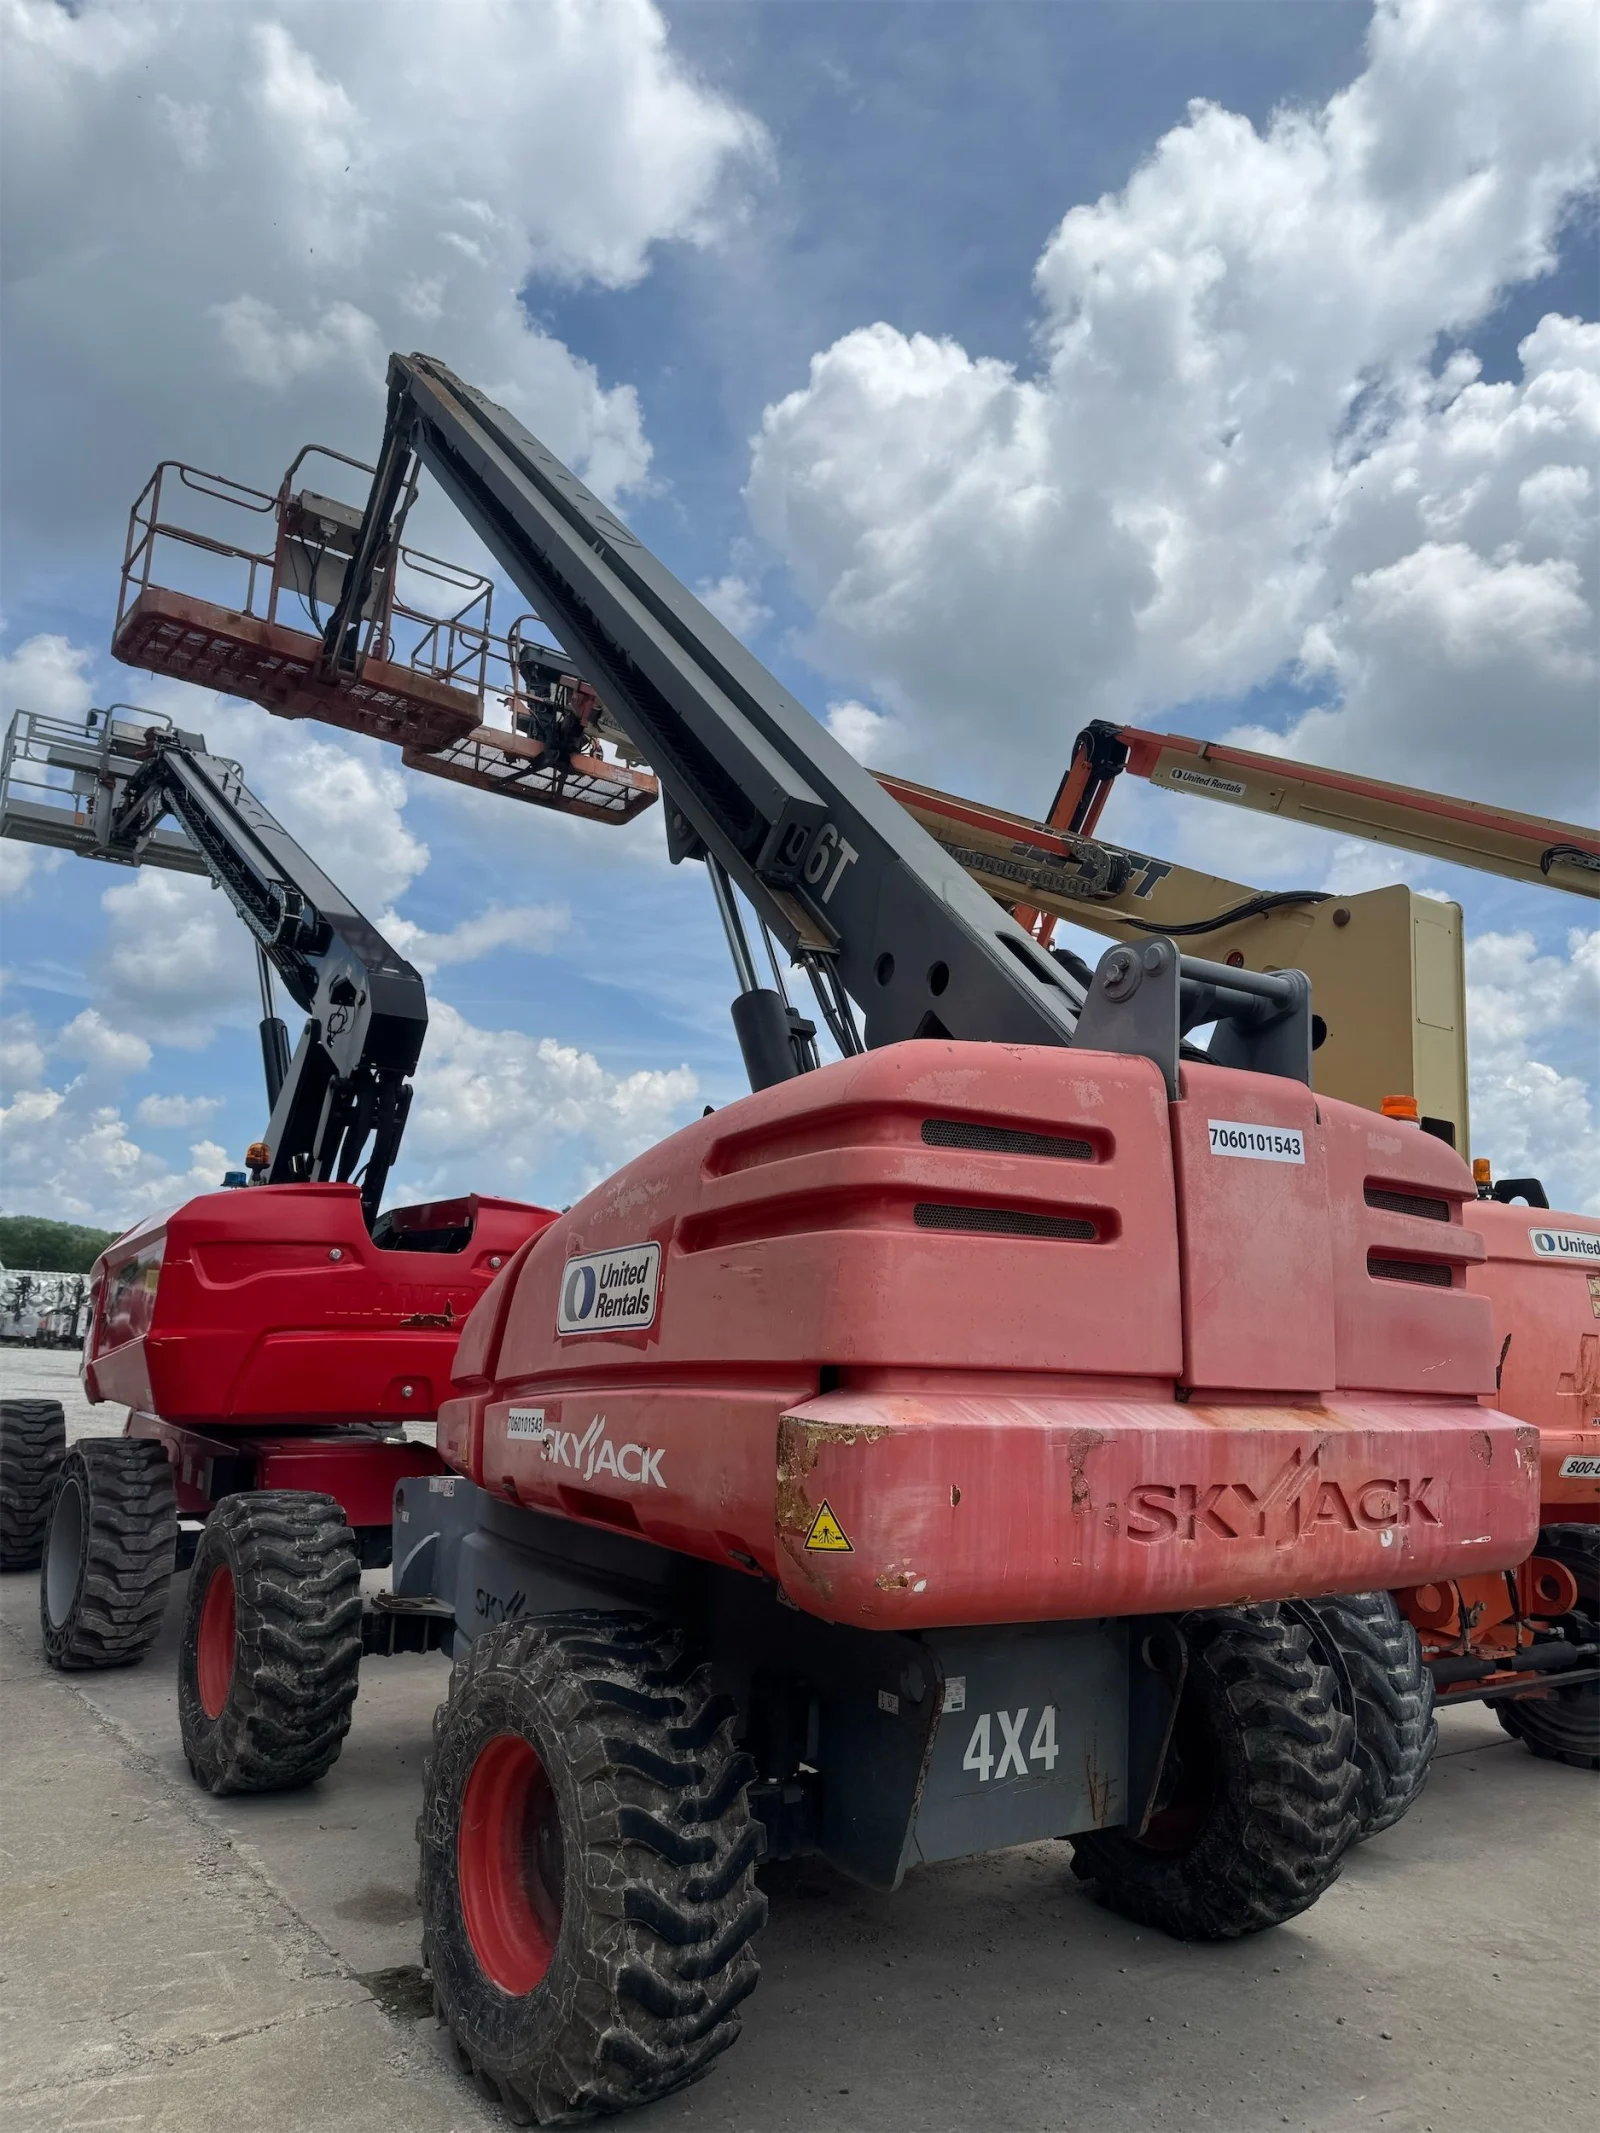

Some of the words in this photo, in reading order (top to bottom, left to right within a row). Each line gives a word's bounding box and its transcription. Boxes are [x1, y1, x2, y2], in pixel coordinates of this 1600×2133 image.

[1183, 772, 1211, 787] United
[1210, 778, 1242, 794] Rentals
[1209, 1127, 1301, 1156] 7060101543
[599, 1256, 650, 1289] United
[595, 1288, 650, 1318] Rentals
[540, 1413, 668, 1489] SKYJACK
[1126, 1446, 1437, 1552] SKYJACK
[962, 1704, 1060, 1782] 4X4
